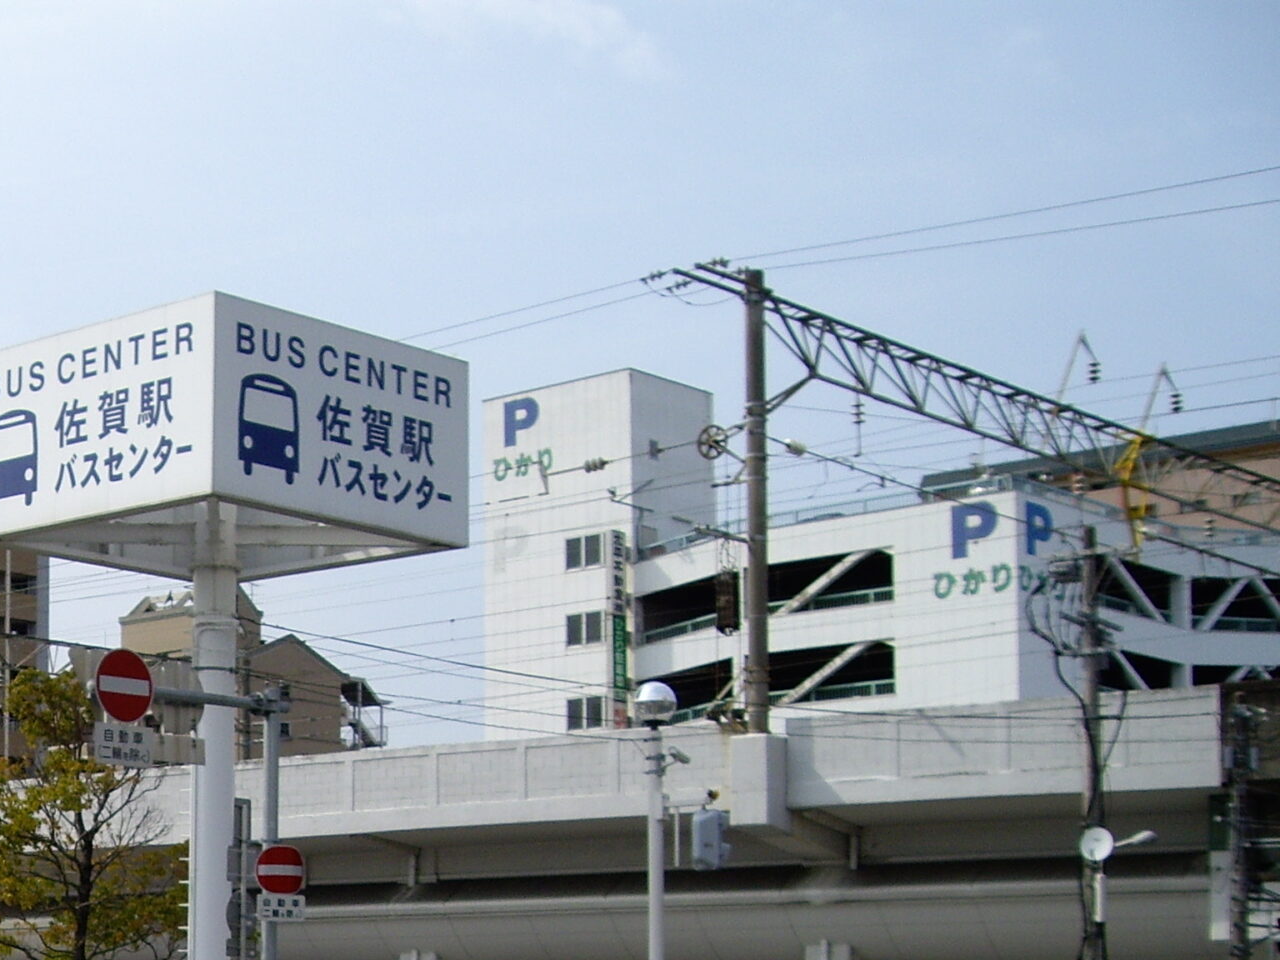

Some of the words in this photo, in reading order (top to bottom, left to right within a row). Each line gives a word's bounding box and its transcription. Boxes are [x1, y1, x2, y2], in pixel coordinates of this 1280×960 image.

[57, 322, 194, 384] CENTER
[237, 322, 306, 369] BUS
[319, 345, 452, 409] CENTER
[54, 376, 174, 448] 佐賀駅
[316, 394, 435, 467] 佐賀駅
[504, 397, 540, 448] P
[55, 435, 193, 493] バスセンター
[317, 453, 453, 510] バスセンター
[494, 448, 553, 482] ひかり
[951, 501, 998, 559] P
[1026, 501, 1053, 556] P
[933, 562, 1012, 599] ひかり
